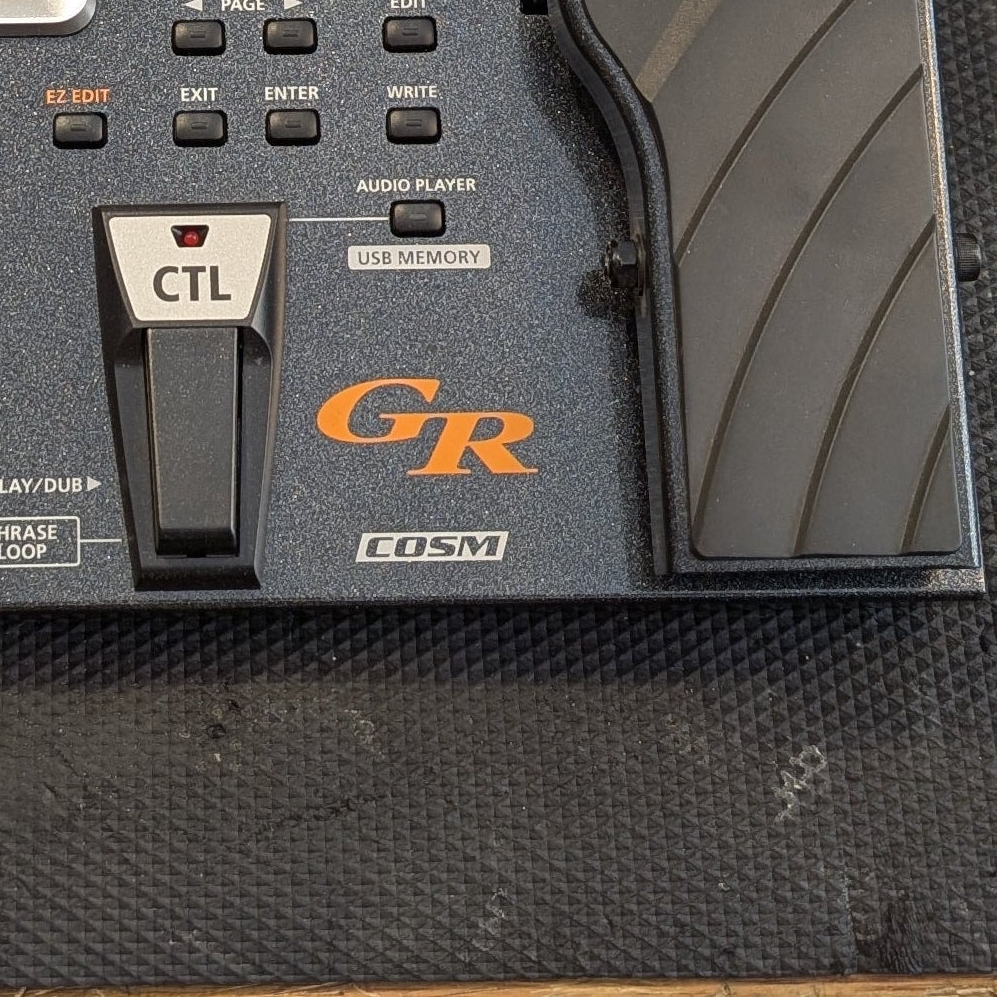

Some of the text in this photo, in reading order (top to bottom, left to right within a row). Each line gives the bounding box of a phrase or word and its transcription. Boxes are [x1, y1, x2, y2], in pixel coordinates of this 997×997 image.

[46, 88, 110, 104] EZ EDIT
[180, 87, 219, 103] EXIT
[264, 85, 319, 101] ENTER
[386, 85, 437, 99] WRITE
[356, 177, 476, 193] AUDIO PLAYER
[357, 249, 481, 266] USB MEMORY
[152, 265, 232, 303] CTL
[316, 378, 539, 475] GR
[365, 535, 502, 558] COSM
